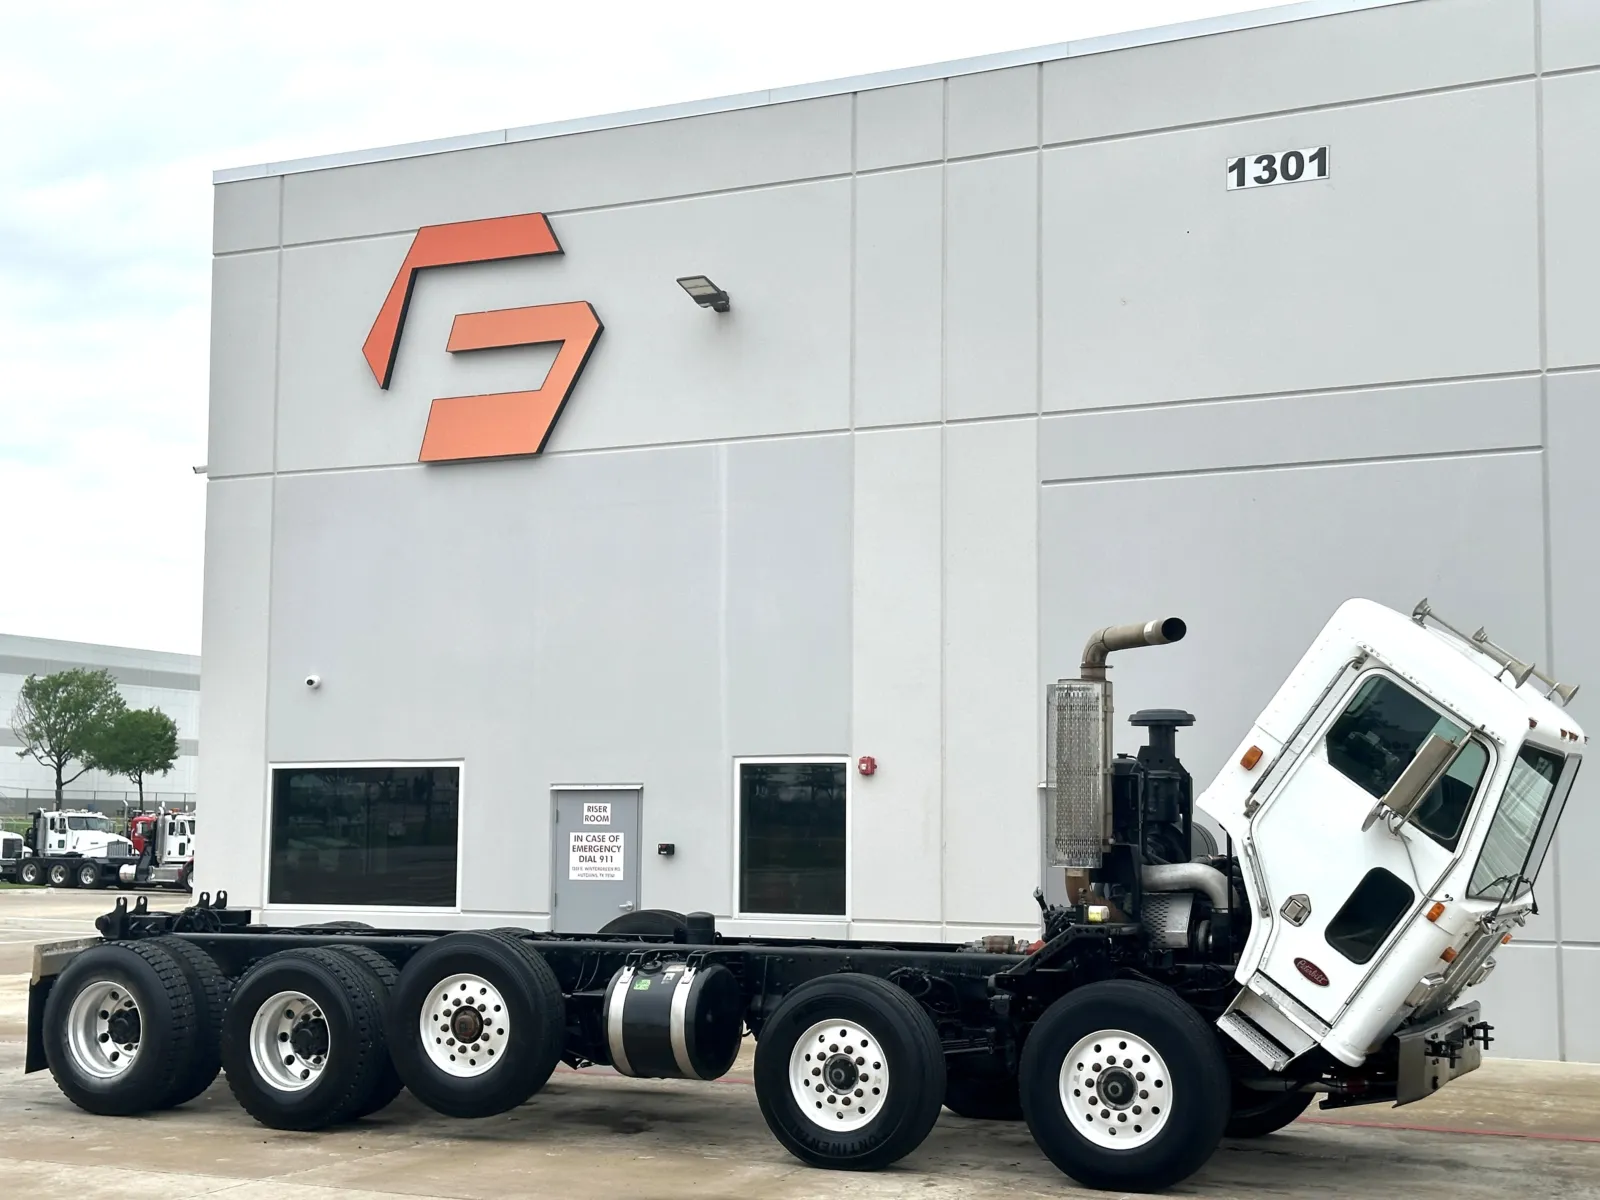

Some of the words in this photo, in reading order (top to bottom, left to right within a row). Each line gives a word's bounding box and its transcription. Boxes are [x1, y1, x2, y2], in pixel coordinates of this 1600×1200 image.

[1228, 146, 1327, 187] 1301
[587, 805, 608, 813] RISER
[1296, 960, 1328, 984] Peterbilt
